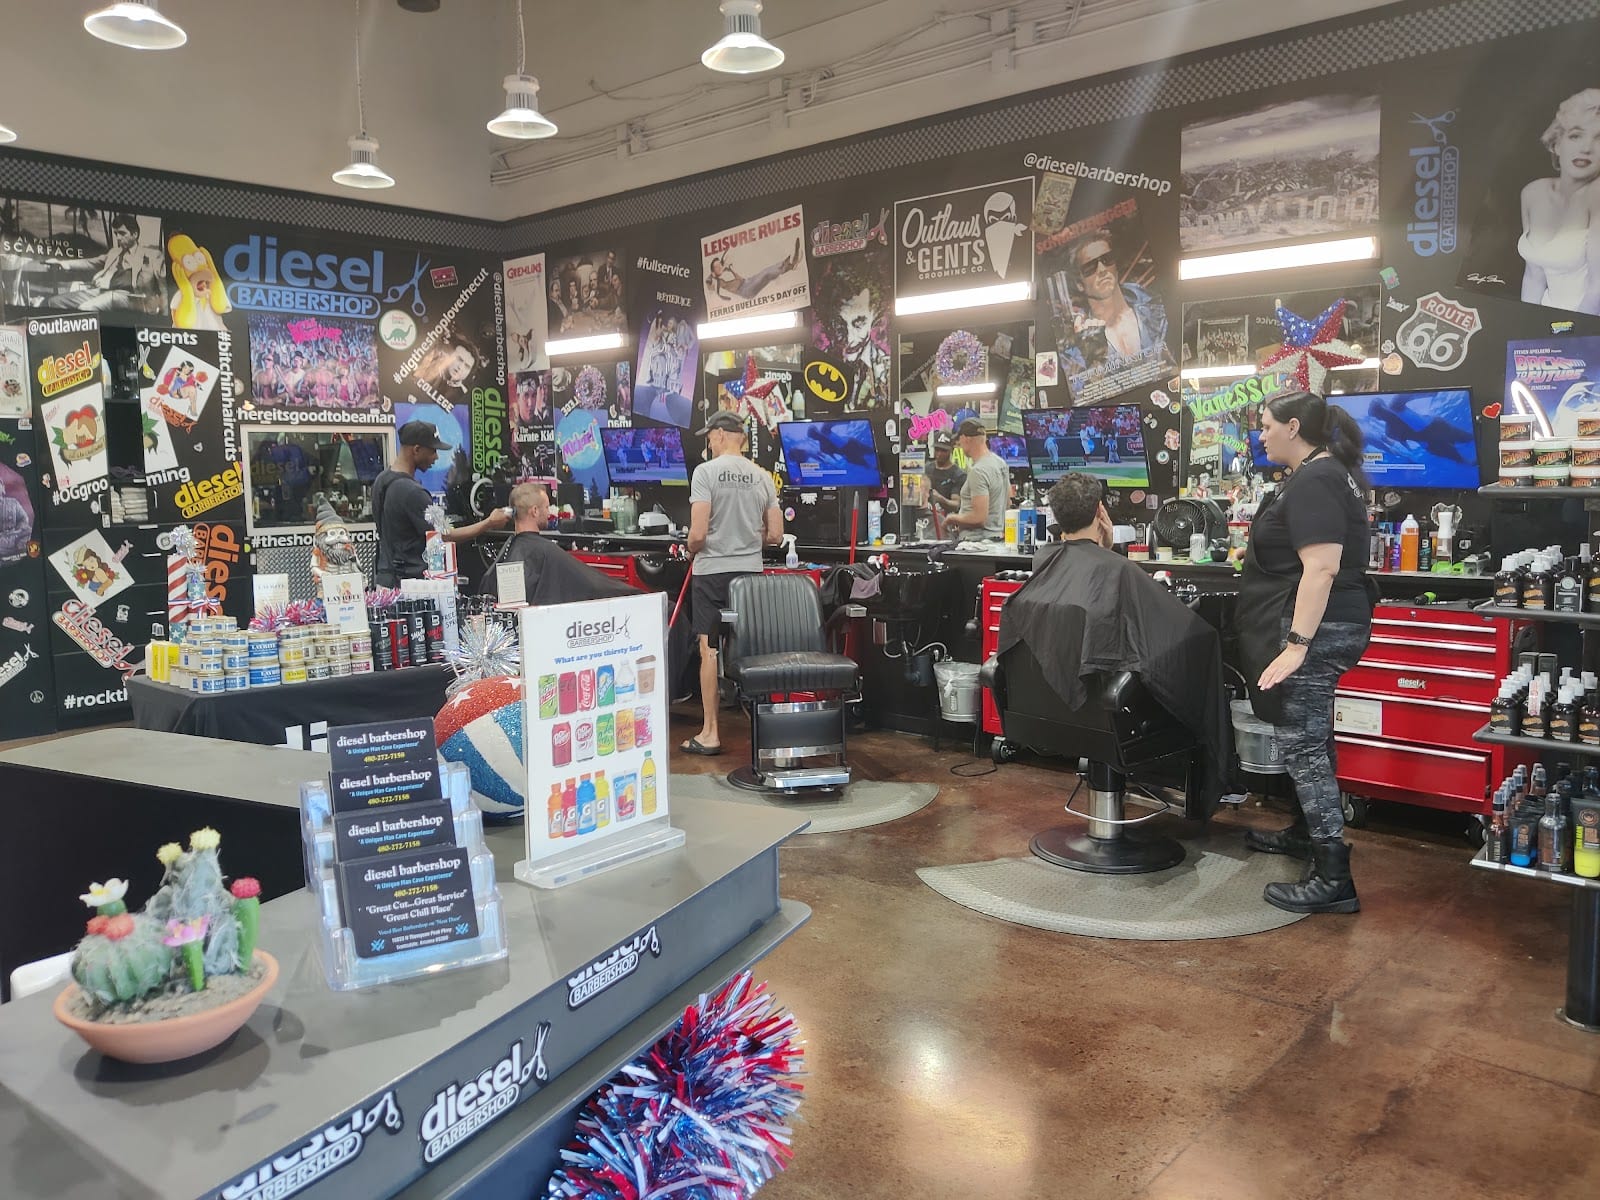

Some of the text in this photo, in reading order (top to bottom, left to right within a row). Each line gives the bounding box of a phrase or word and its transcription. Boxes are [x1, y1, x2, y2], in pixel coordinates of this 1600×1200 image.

[1023, 152, 1171, 196] @dieselbarbershop
[1407, 146, 1441, 257] diesel
[1442, 152, 1457, 247] BARBERSHOP
[704, 212, 801, 257] LEISURE RULES
[811, 212, 870, 244] diesel
[902, 203, 981, 248] Outlaws
[3, 240, 84, 259] SCARFACE
[32, 237, 70, 248] PACINO
[815, 238, 866, 254] BARBERSHOP
[905, 240, 985, 273] & GENTS
[224, 234, 384, 293] diesel
[506, 261, 542, 280] GREMLINS
[637, 256, 690, 279] #fullservice
[918, 265, 988, 280] GROOMING CO.
[237, 286, 373, 315] BARBERSHOP
[710, 285, 807, 319] FERRIS BUELLER'S DAY OFF
[1426, 298, 1475, 328] ROUTE
[28, 317, 198, 347] @outlawan dgents
[392, 266, 489, 385] #digtheshoplovethecut
[493, 272, 506, 386] @dieselbarbershop
[1407, 322, 1460, 363] 66
[38, 341, 92, 385] diesel
[1514, 356, 1584, 371] BACK
[1526, 369, 1584, 384] FUTURE
[217, 330, 236, 462] #bitchinhaircuts
[416, 378, 455, 413] COLLEGE
[1189, 373, 1281, 421] Vanessa
[473, 391, 484, 472] BARBERSHOP
[484, 387, 507, 470] diese
[514, 429, 555, 443] Karate Kid
[519, 426, 529, 434] The
[908, 409, 950, 440] Jenn
[53, 466, 191, 506] #OGgroo ming
[174, 460, 244, 509] diesel
[718, 470, 753, 484] diesel
[185, 483, 244, 517] BARBERSHOP
[57, 613, 111, 665] BARBERSHOP
[62, 599, 136, 661] diesel
[566, 616, 615, 639] diesel
[569, 634, 613, 648] BARBERSHOP
[554, 644, 643, 664] What are you thirsty for?
[336, 728, 427, 748] diesel barbershop
[340, 770, 432, 790] diesel barbershop
[348, 815, 443, 837] diesel barbershop
[364, 858, 461, 882] diesel barbershop
[366, 904, 392, 915] "Great
[437, 889, 468, 902] Service"
[383, 903, 454, 923] "Great Chill Place"
[573, 953, 637, 1003] BARBERSHOP
[421, 1040, 523, 1142] diesel
[430, 1087, 516, 1158] BARBERSHOP
[245, 1136, 357, 1200] ARBERSHOP
